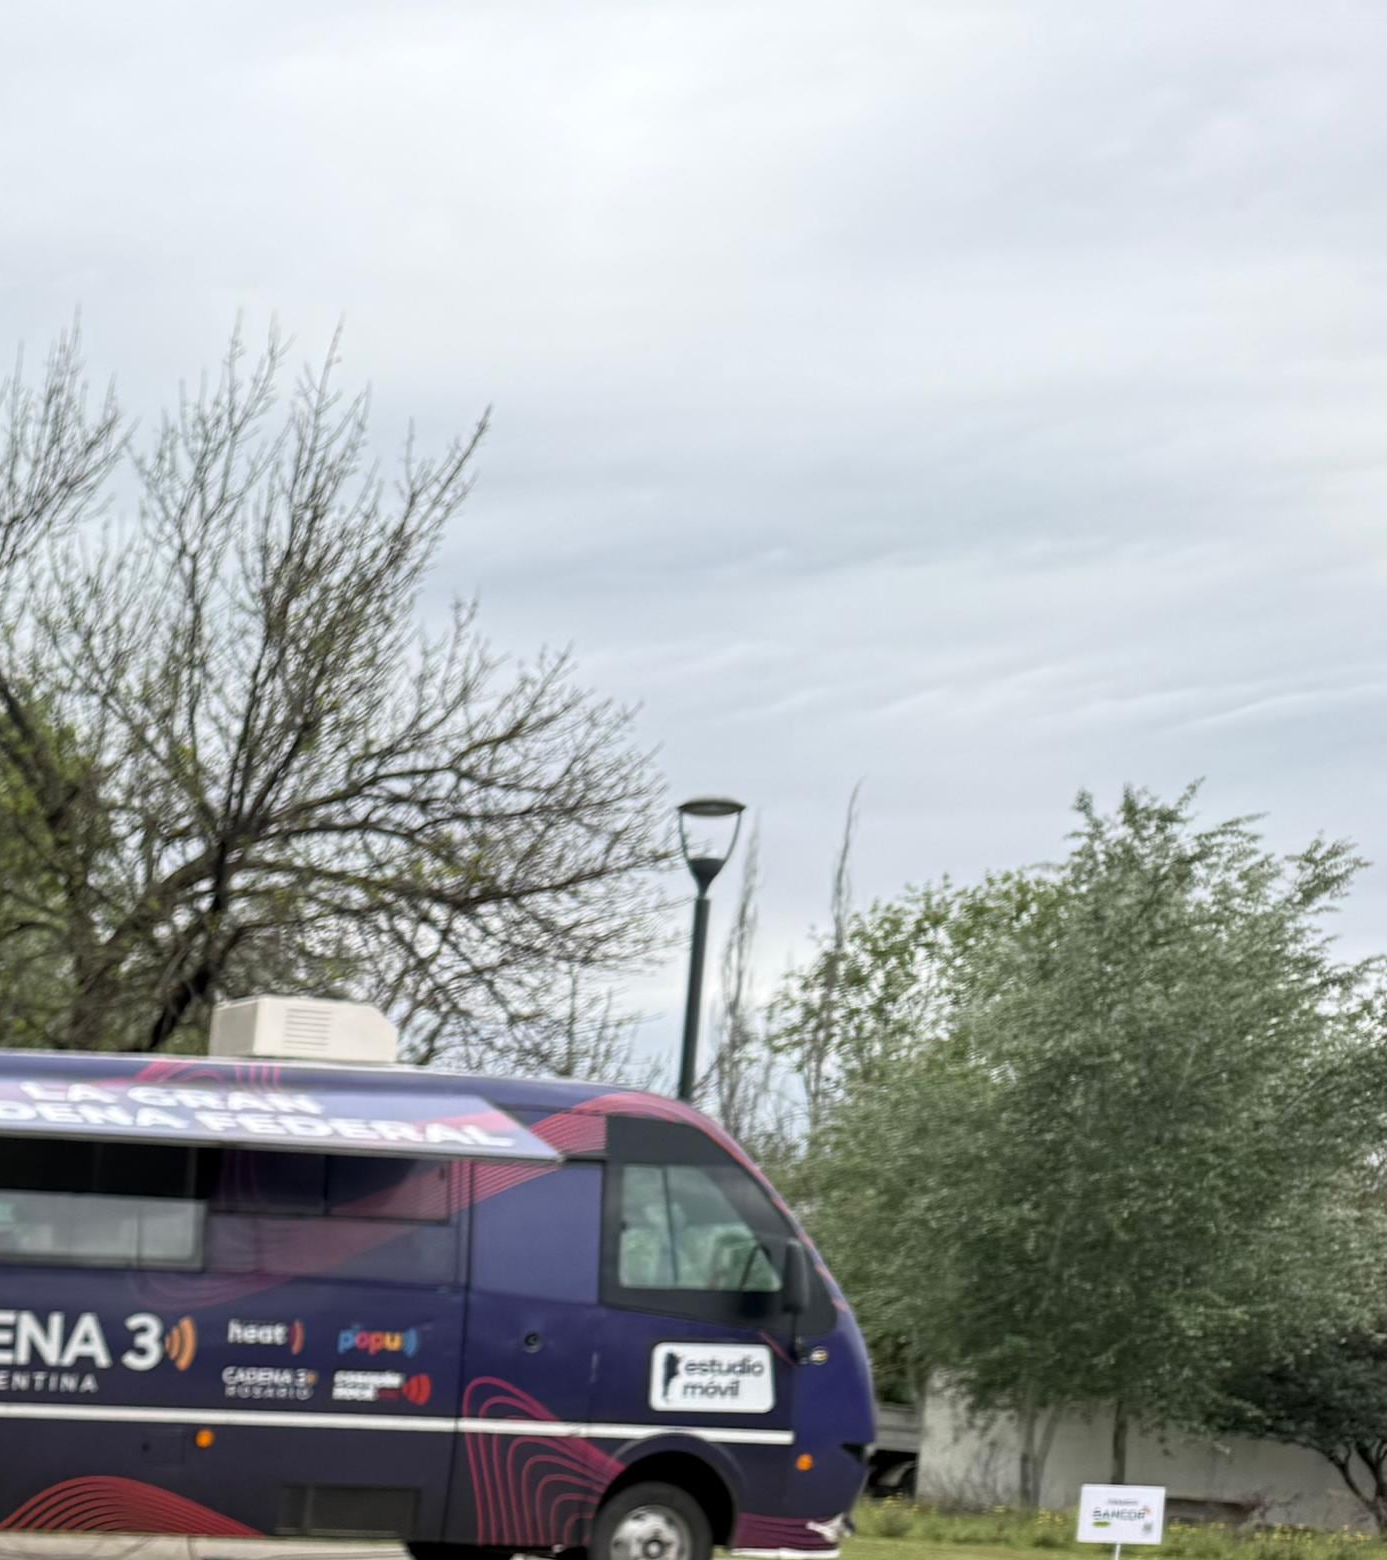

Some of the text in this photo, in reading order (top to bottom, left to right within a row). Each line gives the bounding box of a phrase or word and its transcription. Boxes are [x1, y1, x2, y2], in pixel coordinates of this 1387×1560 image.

[19, 1080, 325, 1116] LA GRAN
[191, 1110, 517, 1148] FEDERAL
[121, 1312, 164, 1371] 3
[228, 1319, 288, 1345] heat
[222, 1367, 291, 1384] CADENA
[685, 1355, 765, 1377] estudio
[682, 1380, 740, 1398] móvil
